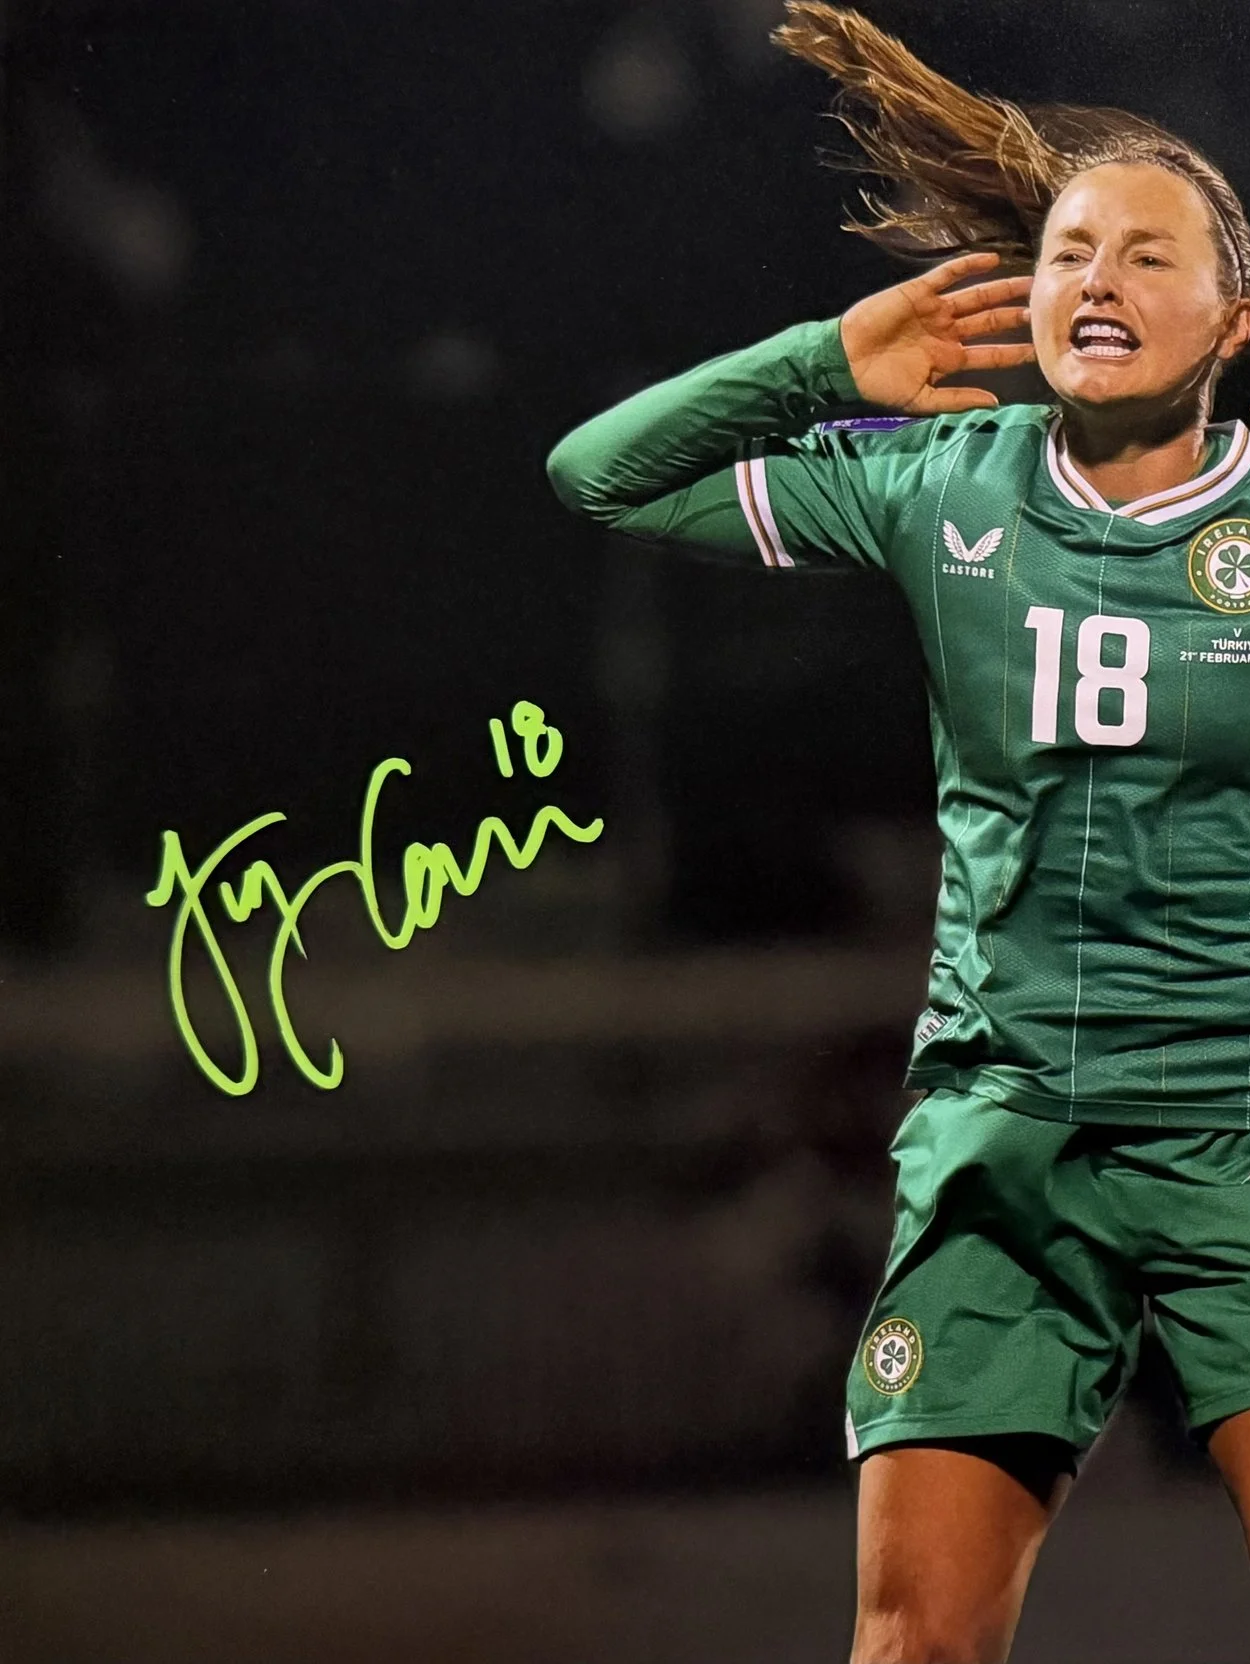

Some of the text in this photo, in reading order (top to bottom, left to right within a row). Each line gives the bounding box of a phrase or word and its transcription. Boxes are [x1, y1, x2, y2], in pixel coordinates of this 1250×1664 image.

[942, 563, 995, 579] CASTORE
[1233, 627, 1243, 638] V
[1024, 605, 1150, 747] 18
[490, 701, 563, 777] 18
[870, 1324, 916, 1350] IRELAND
